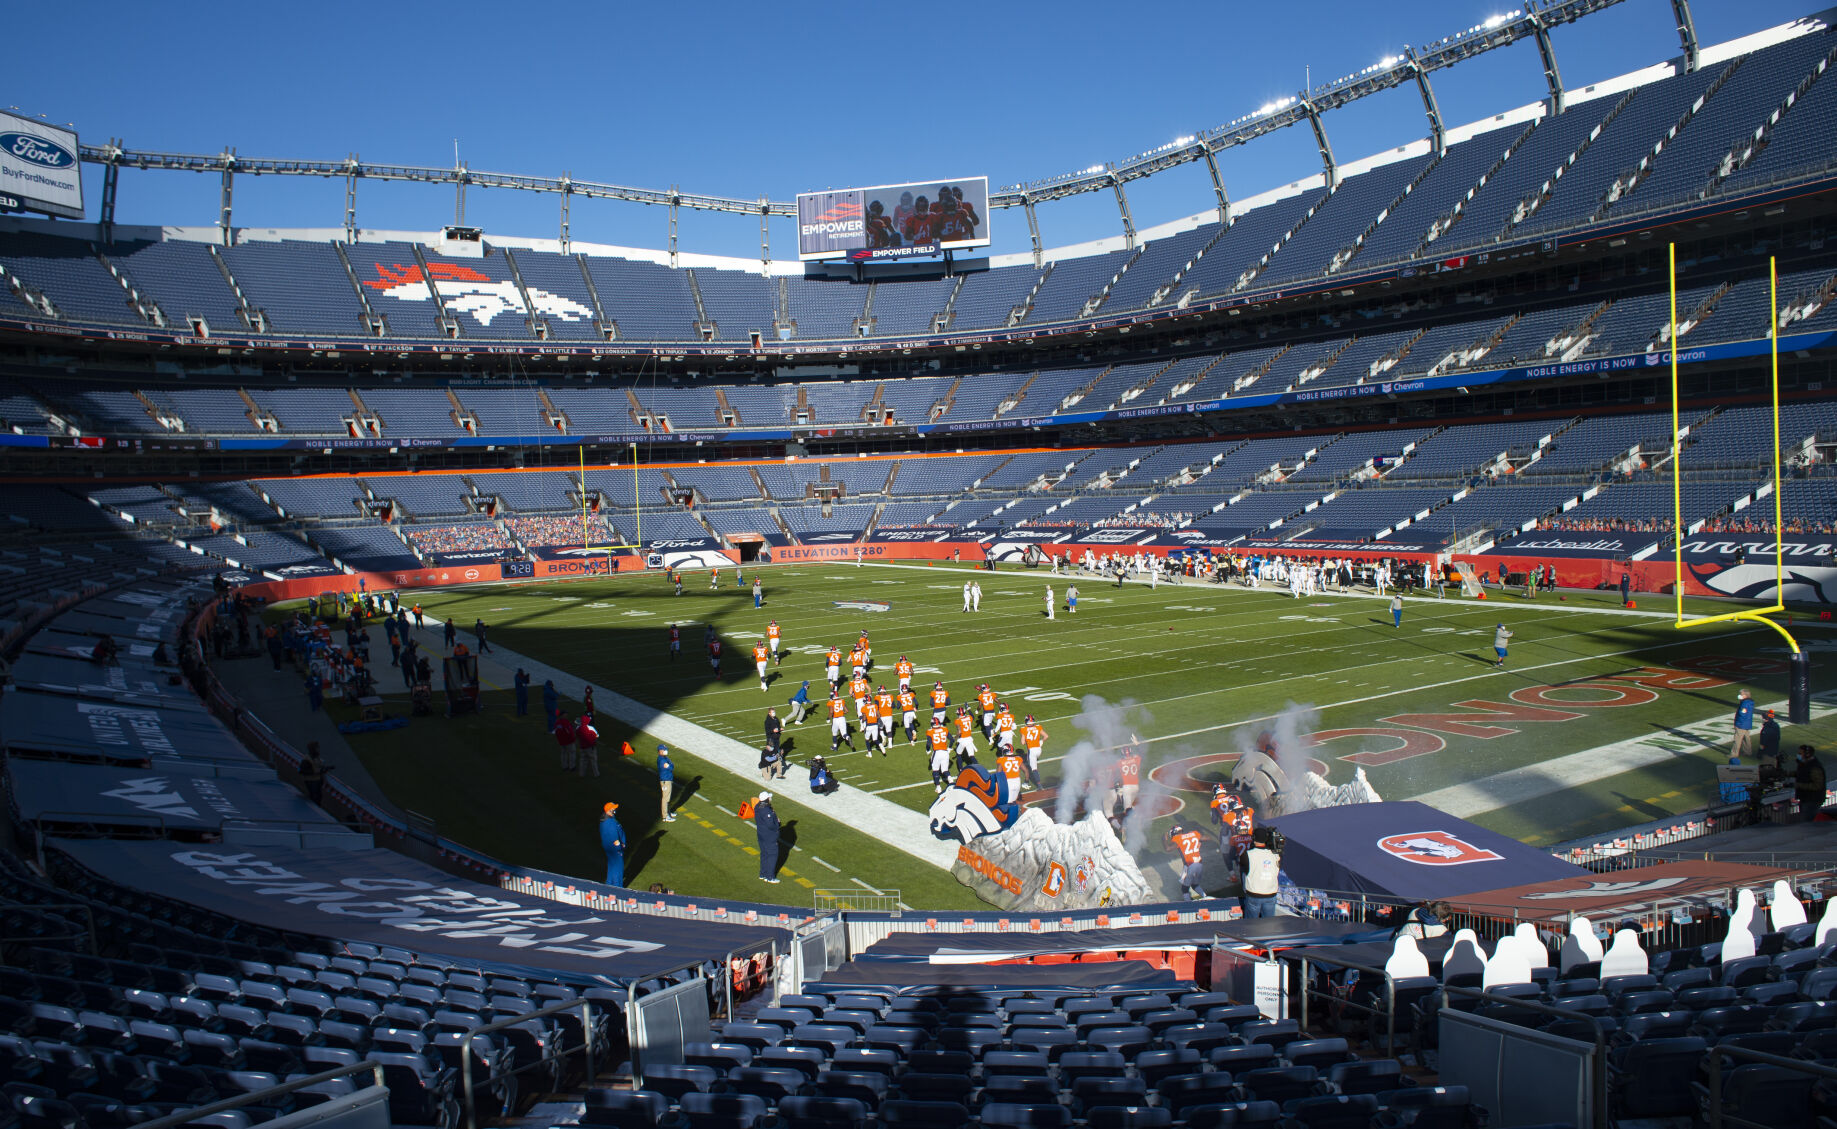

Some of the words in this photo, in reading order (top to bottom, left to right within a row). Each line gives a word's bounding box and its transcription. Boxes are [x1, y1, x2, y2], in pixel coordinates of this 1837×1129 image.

[12, 135, 61, 165] Ford
[2, 166, 75, 191] BuyFordNow.com
[802, 221, 863, 236] EMPOWER
[872, 247, 912, 257] EMPOWER
[913, 245, 936, 254] FIELD
[1526, 366, 1556, 378] NOBLE
[1559, 361, 1597, 375] ENERGY
[1599, 360, 1609, 370] IS
[1611, 357, 1636, 370] NOW
[1296, 392, 1319, 401] NOBLE
[1320, 389, 1348, 399] ENERGY
[1350, 387, 1357, 396] IS
[1358, 386, 1376, 395] NOW
[1393, 380, 1425, 392] Chevron
[1118, 410, 1136, 418] NOBLE
[1138, 408, 1159, 417] ENERGY
[1167, 405, 1182, 414] NOW
[1195, 401, 1220, 411] Chevron
[971, 422, 993, 430] ENERGY
[1002, 420, 1017, 428] NOW
[1031, 417, 1054, 426] Chevron
[306, 440, 332, 448] NOBLE
[333, 440, 365, 448] ENERGY
[376, 439, 394, 447] NOW
[412, 438, 442, 447] Chevron
[689, 433, 715, 442] Chevron
[672, 488, 691, 496] xfinity
[367, 500, 389, 508] xfinity
[473, 496, 494, 504] xfinity
[650, 539, 705, 549] Ford
[1516, 539, 1623, 551] uchealth
[443, 551, 502, 560] verizon
[780, 547, 848, 559] ELEVATION
[650, 556, 661, 566] 25
[510, 564, 531, 575] 9:28
[830, 655, 839, 663] 43
[899, 666, 910, 674] 35
[854, 683, 865, 692] 88
[880, 698, 892, 708] 73
[900, 697, 913, 706] 33
[935, 695, 947, 704] 28
[982, 696, 994, 706] 34
[833, 704, 844, 712] 54
[868, 708, 877, 717] 41
[962, 721, 972, 732] 31
[1001, 717, 1013, 728] 37
[932, 732, 947, 744] 55
[1026, 729, 1039, 741] 47
[1004, 761, 1020, 773] 93
[1121, 764, 1138, 776] 90
[1182, 837, 1200, 855] 22
[958, 844, 1023, 896] BRONCOS
